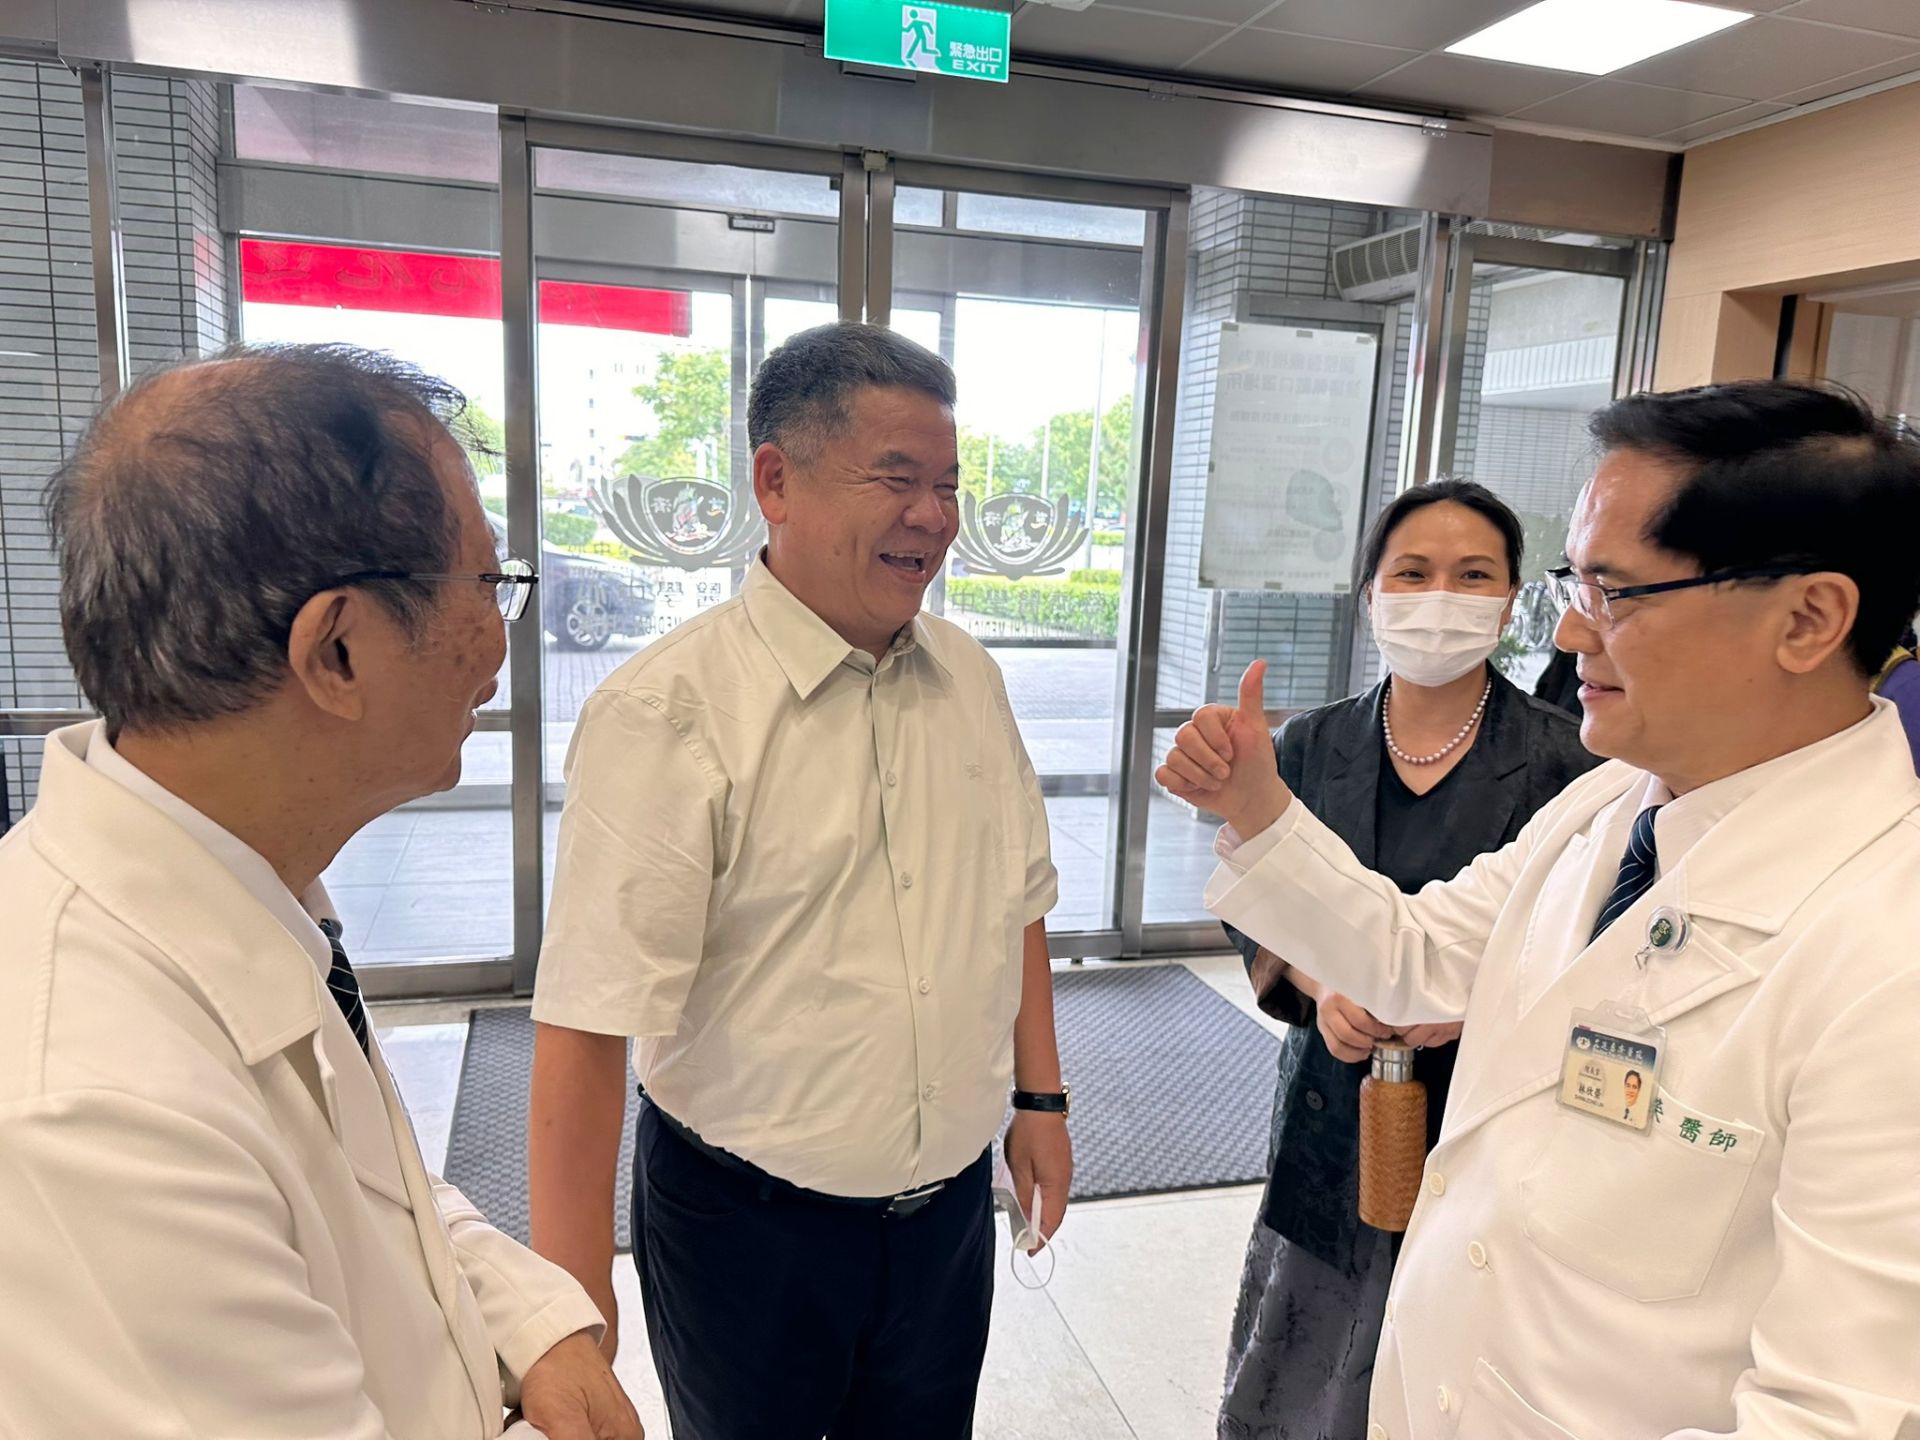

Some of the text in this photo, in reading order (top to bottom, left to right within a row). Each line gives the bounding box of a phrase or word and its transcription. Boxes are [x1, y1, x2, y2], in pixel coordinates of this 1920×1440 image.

[949, 41, 1002, 62] 緊急出口
[952, 59, 1000, 75] EXIT
